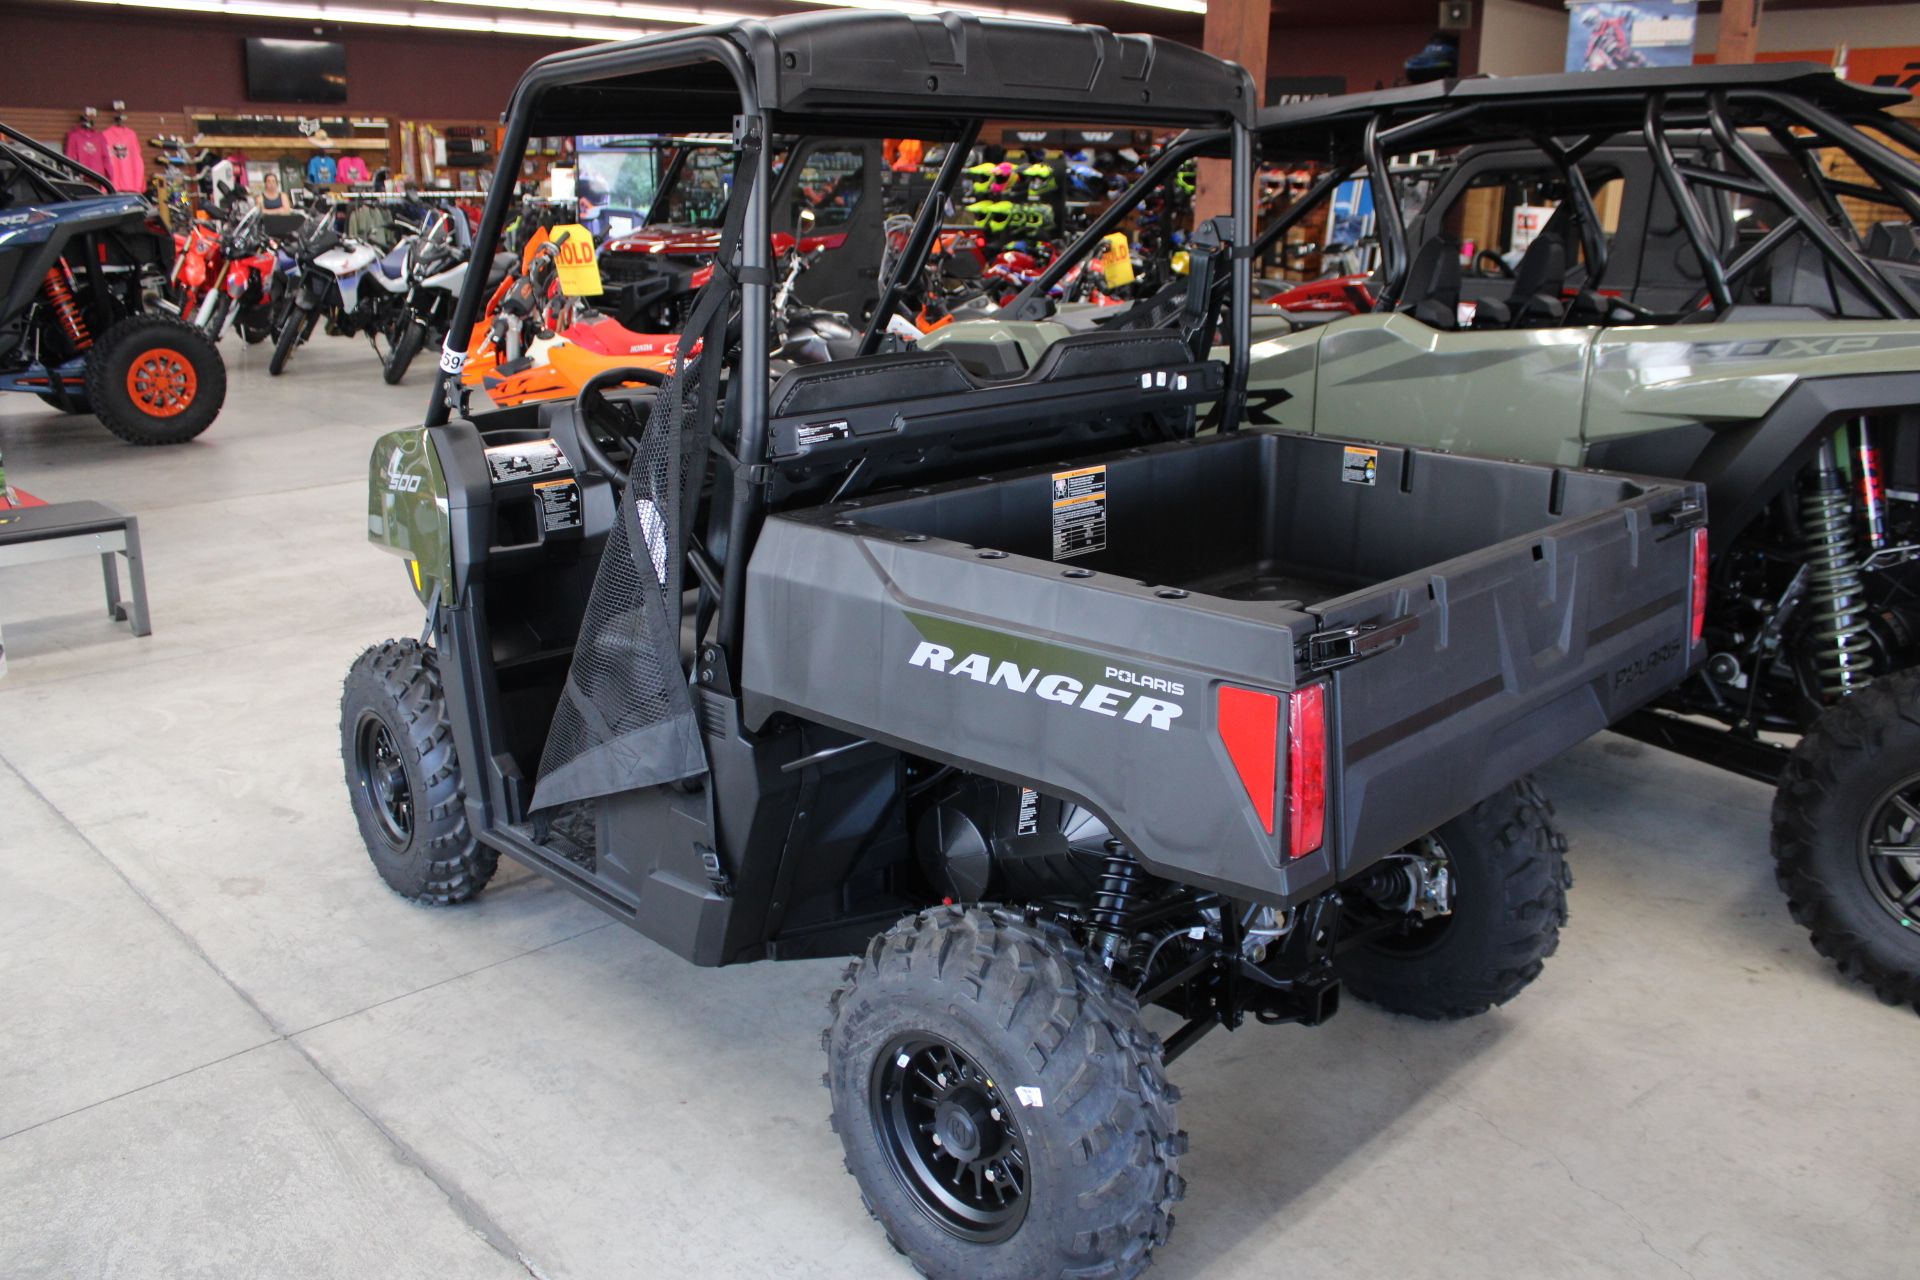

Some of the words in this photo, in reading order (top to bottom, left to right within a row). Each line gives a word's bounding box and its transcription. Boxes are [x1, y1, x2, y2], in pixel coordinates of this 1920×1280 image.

[388, 473, 421, 493] 500
[908, 641, 1183, 731] RANGER
[1105, 666, 1184, 696] POLARIS
